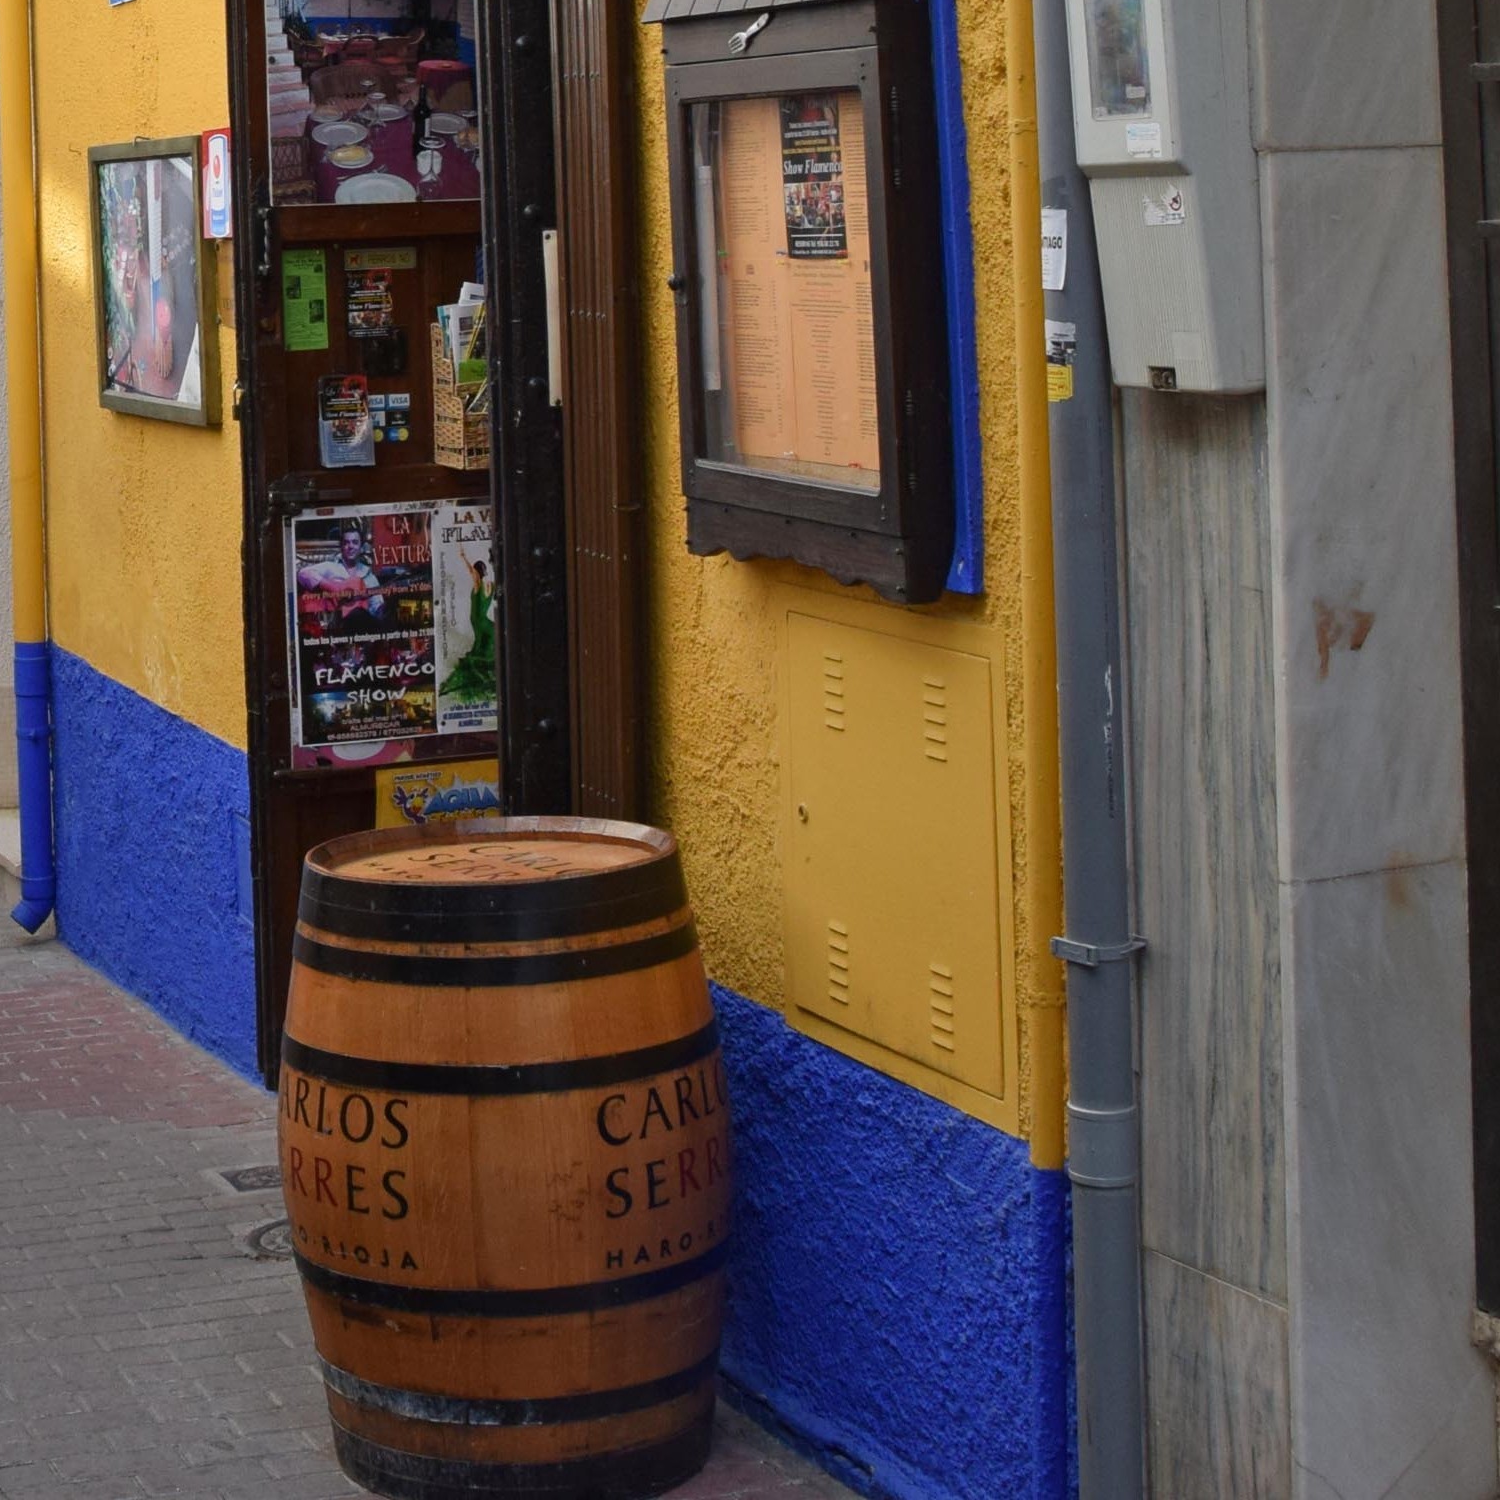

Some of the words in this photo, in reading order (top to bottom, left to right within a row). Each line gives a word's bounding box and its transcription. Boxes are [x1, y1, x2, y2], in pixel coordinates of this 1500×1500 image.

[392, 516, 411, 535] LA
[453, 510, 475, 525] LA
[315, 662, 435, 686] FLAMENCO
[347, 686, 406, 706] SHOW
